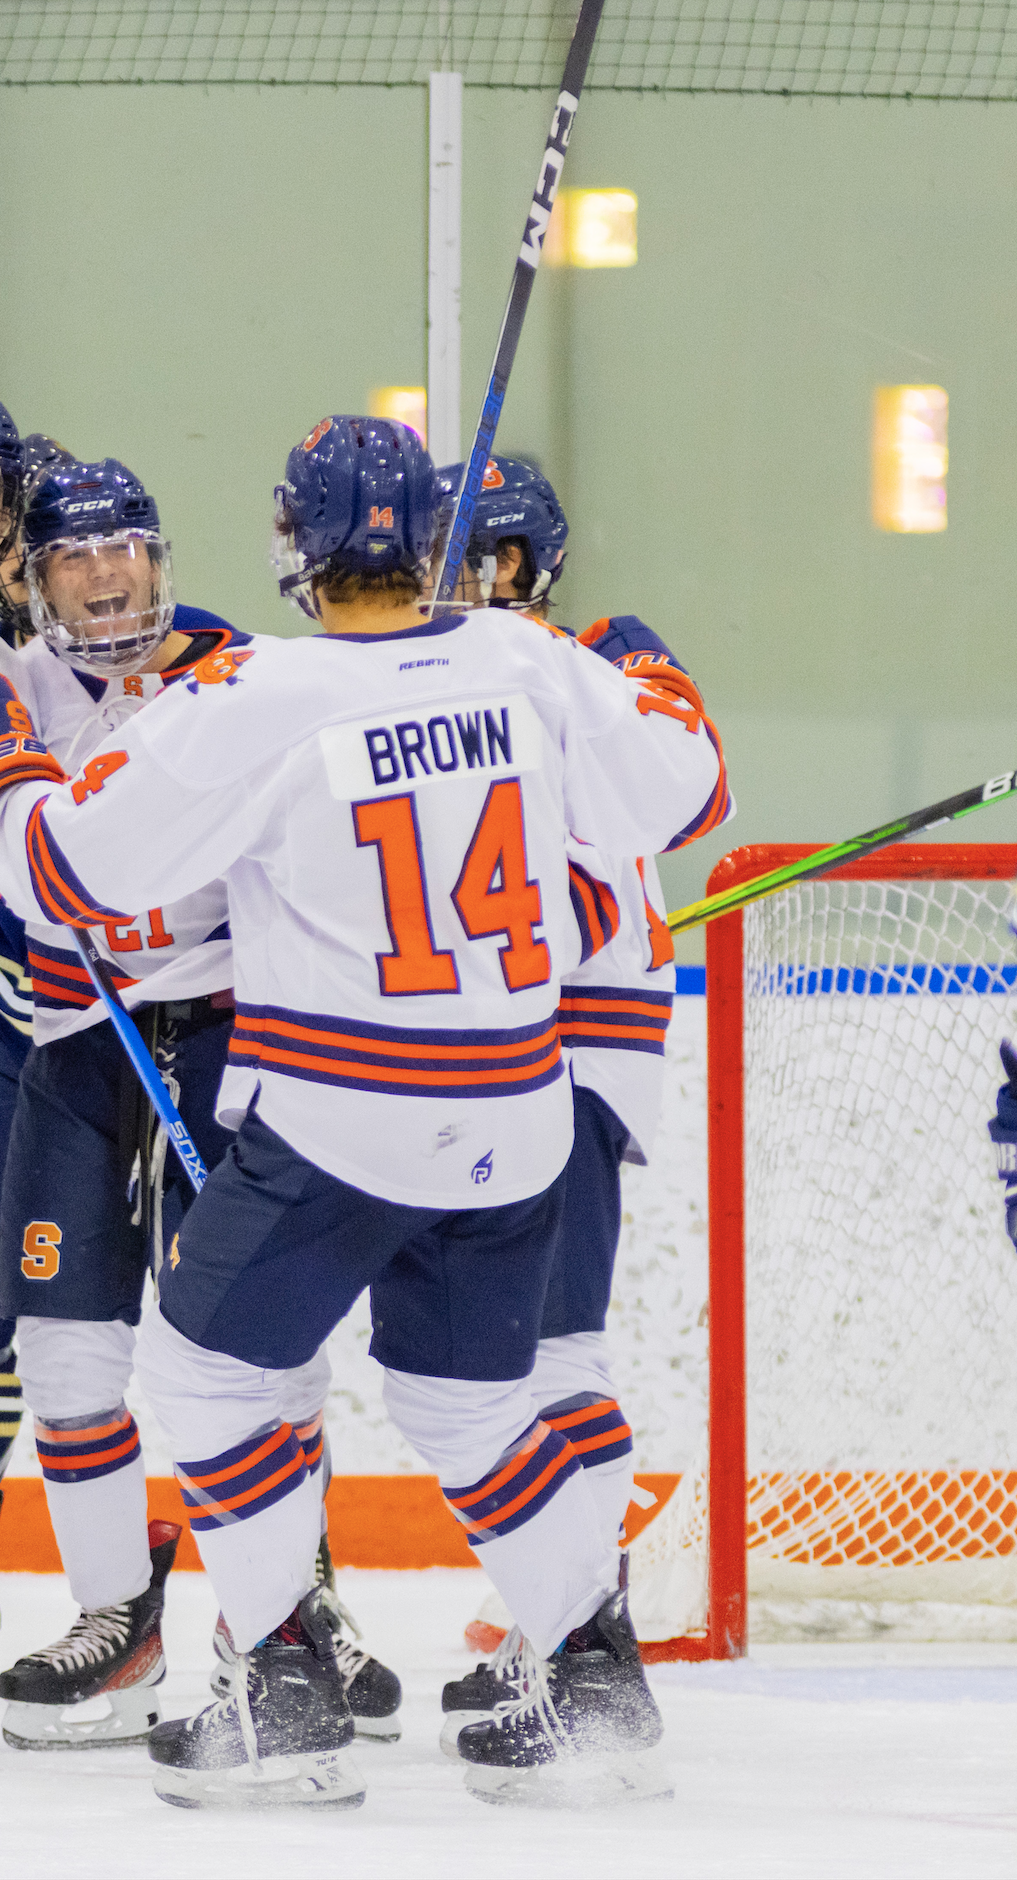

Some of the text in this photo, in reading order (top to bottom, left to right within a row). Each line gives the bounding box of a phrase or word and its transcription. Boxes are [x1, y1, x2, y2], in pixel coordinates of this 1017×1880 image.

[518, 90, 579, 269] CCM
[444, 375, 507, 567] JETSPEED
[67, 498, 115, 513] CCM
[369, 505, 394, 528] 14
[487, 512, 525, 527] CCM
[399, 658, 449, 671] REBIRTH
[123, 675, 143, 697] S
[5, 700, 33, 734] S
[363, 706, 514, 786] BROWN
[350, 776, 553, 997] 14
[20, 1220, 63, 1281] S
[280, 1675, 309, 1686] MACH
